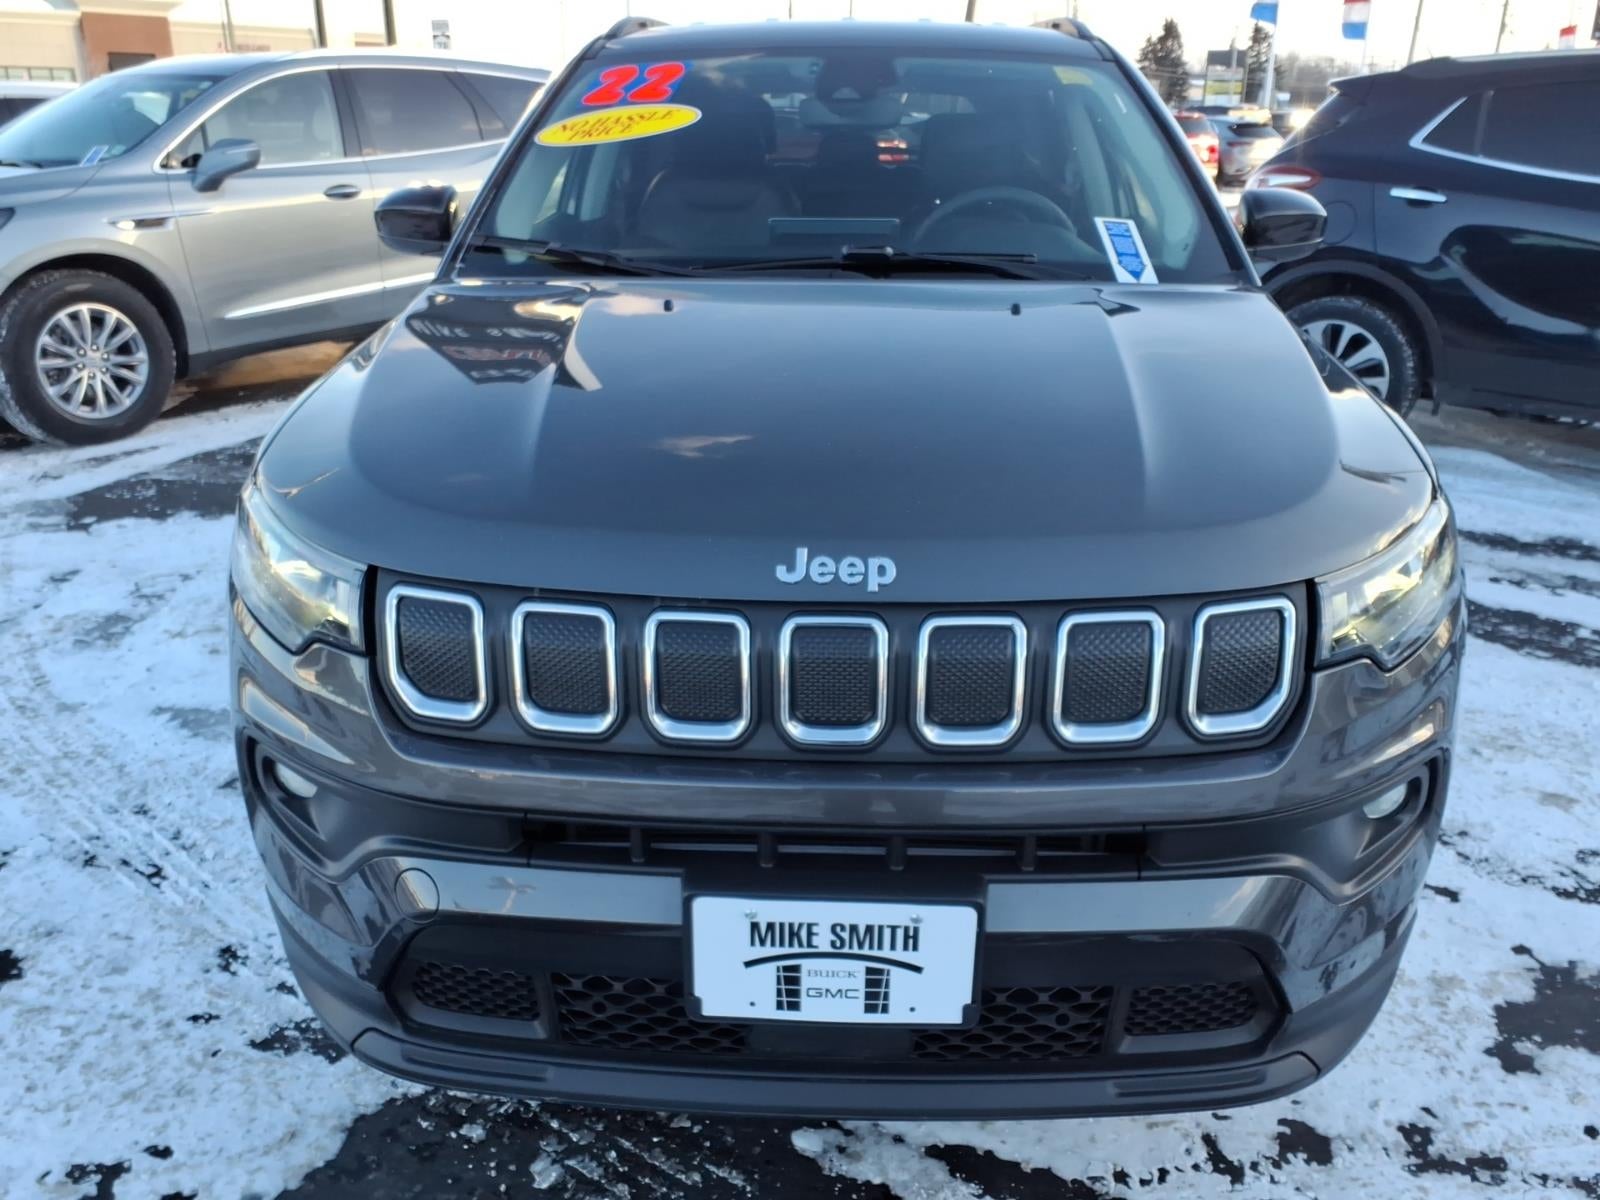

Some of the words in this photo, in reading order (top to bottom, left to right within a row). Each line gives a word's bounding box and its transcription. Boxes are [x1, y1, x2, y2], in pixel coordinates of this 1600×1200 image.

[582, 62, 685, 105] 22
[776, 547, 897, 592] Jeep
[750, 921, 820, 949] MIKE
[829, 923, 920, 952] SMITH
[807, 969, 857, 979] BUICK
[806, 987, 860, 999] GMC
